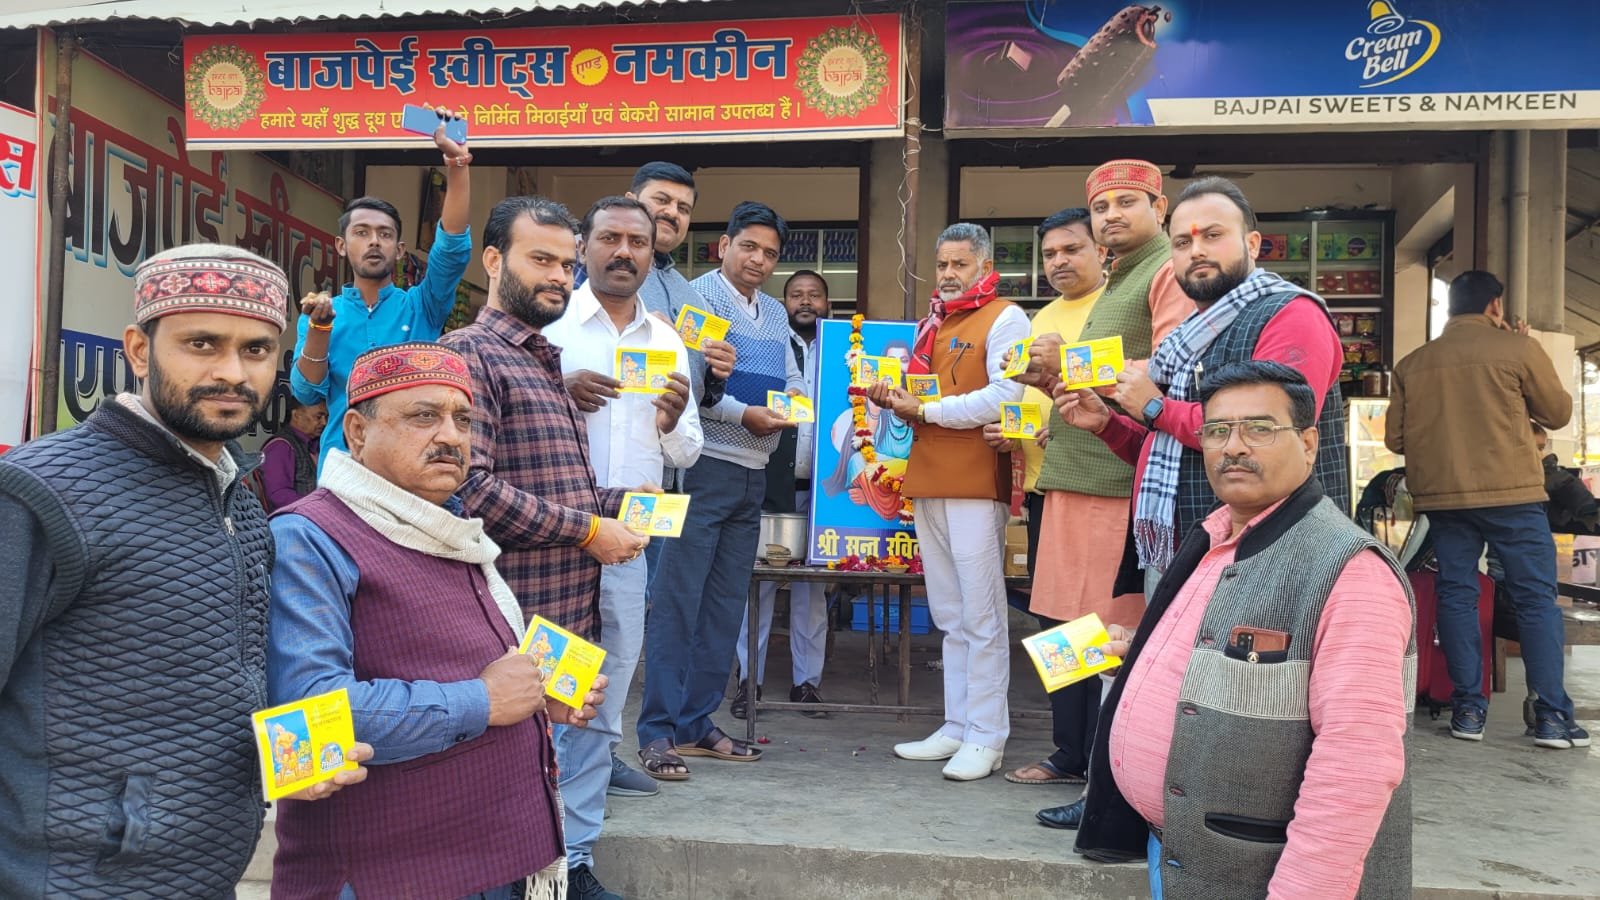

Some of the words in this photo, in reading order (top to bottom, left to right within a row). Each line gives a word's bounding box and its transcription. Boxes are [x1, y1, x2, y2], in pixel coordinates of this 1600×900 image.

[1345, 29, 1423, 61] Cream
[264, 36, 420, 96] बाजपेई
[426, 36, 571, 99] स्वीट्स
[612, 28, 793, 84] नमकीन
[1362, 48, 1409, 80] Bell
[260, 106, 296, 129] हमारे
[301, 106, 329, 129] यहाँ
[332, 111, 361, 134] शुद्ध
[364, 112, 386, 133] दूध
[474, 103, 520, 126] निर्मित
[592, 102, 615, 125] एवं
[619, 101, 660, 123] बेकरी
[664, 105, 715, 122] सामान
[720, 102, 775, 120] उपलब्ध
[1214, 98, 1300, 116] BAJPAI
[1309, 96, 1411, 114] SWEETS
[1419, 95, 1437, 112] &
[1445, 92, 1577, 111] NAMKEEN
[817, 528, 840, 556] श्री
